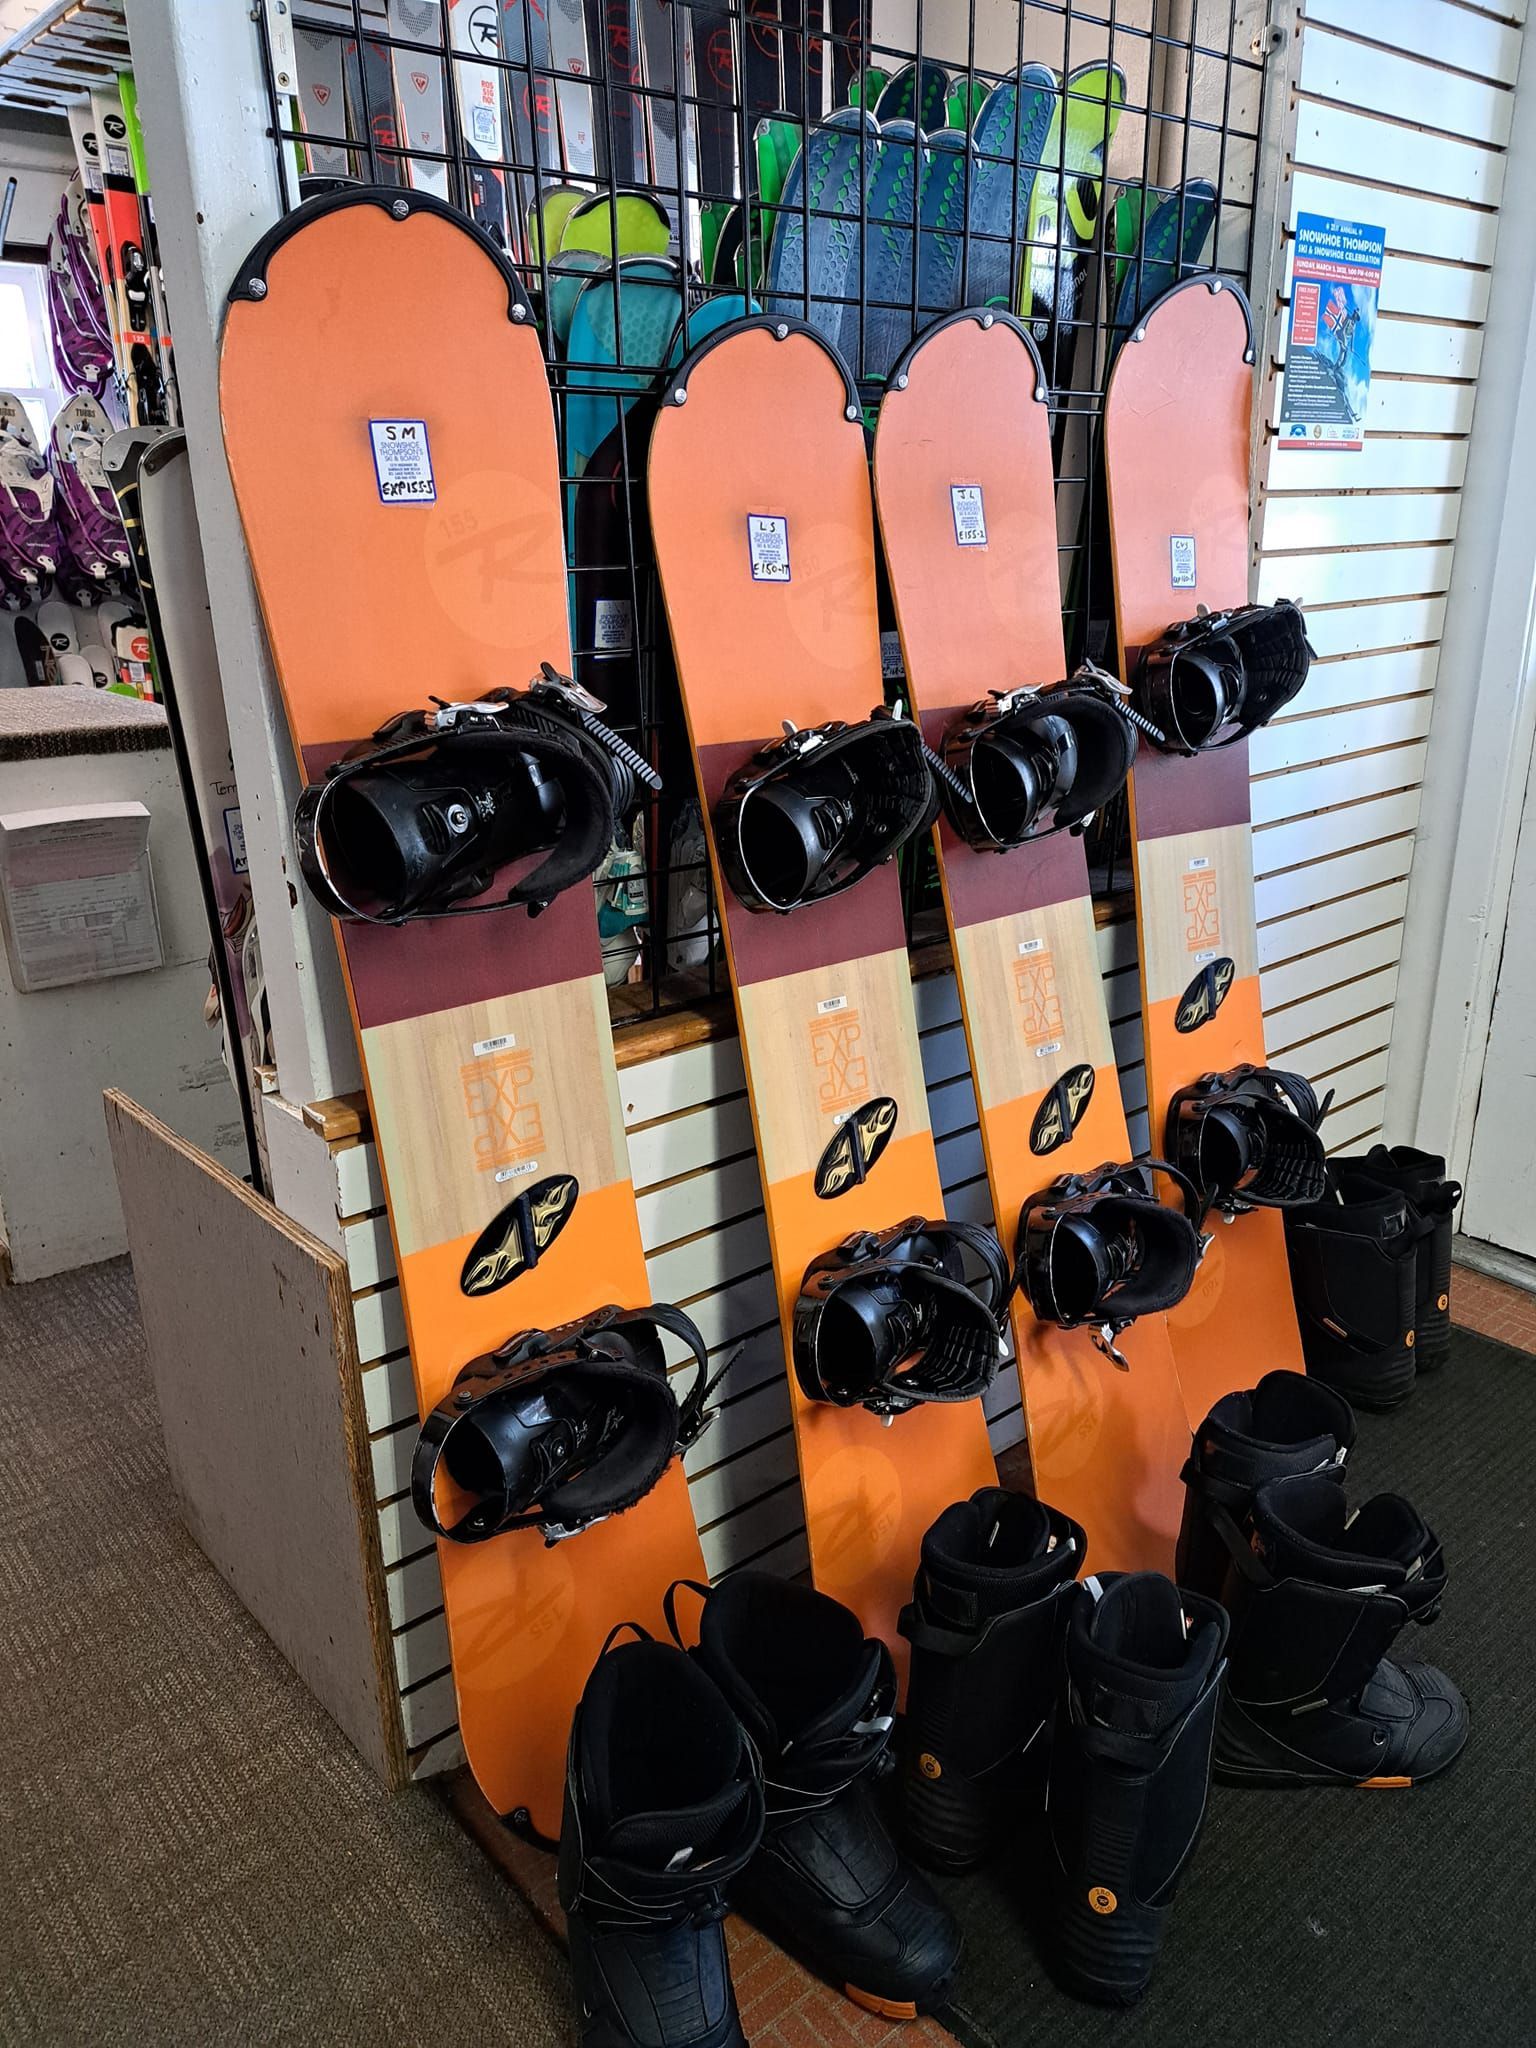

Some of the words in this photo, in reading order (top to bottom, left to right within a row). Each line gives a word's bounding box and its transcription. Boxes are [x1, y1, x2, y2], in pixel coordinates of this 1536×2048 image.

[1299, 228, 1342, 247] SNOWSHOE
[1342, 236, 1382, 255] THOMPSON
[1298, 244, 1308, 253] SKI
[1314, 246, 1345, 260] SNOWSHOE
[1345, 252, 1381, 265] CELEBRATION
